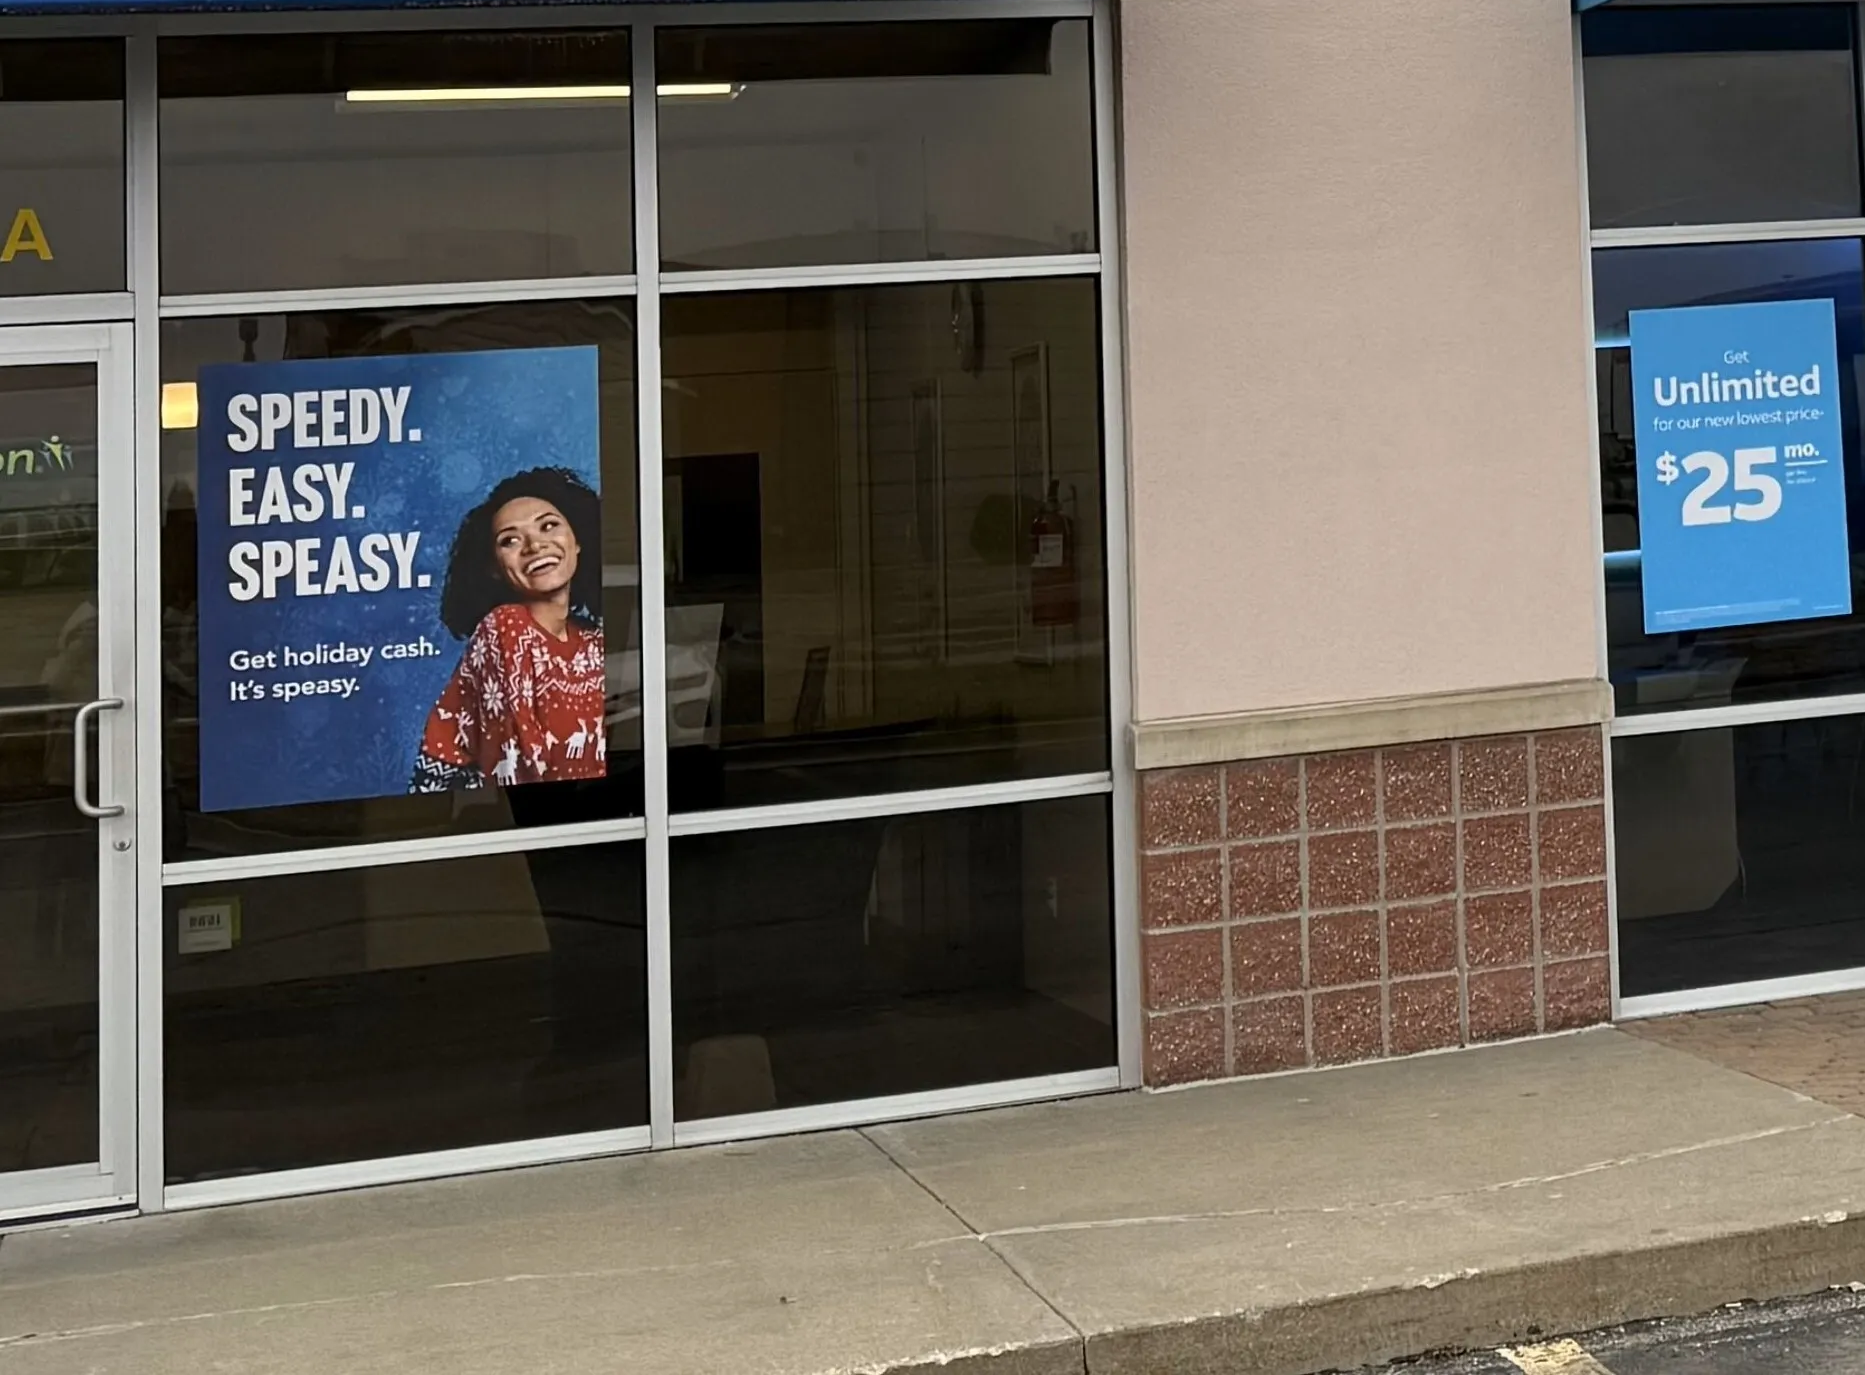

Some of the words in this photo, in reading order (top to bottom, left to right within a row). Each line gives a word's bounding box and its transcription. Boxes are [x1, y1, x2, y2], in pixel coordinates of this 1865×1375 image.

[1723, 350, 1750, 364] Get
[1654, 364, 1820, 406] Unlimited
[227, 386, 422, 453] SPEEDY.
[1653, 416, 1673, 432] for
[1677, 418, 1701, 430] our
[1704, 415, 1735, 428] new
[1737, 410, 1782, 425] lowest
[228, 462, 365, 526] EASY.
[1655, 446, 1783, 526] $25
[1784, 443, 1820, 458] mo.
[228, 531, 431, 601] SPEASY.
[230, 649, 276, 671] Get
[284, 641, 374, 668] holiday
[381, 635, 441, 659] cash.
[230, 680, 265, 701] It's
[272, 676, 360, 703] speasy.
